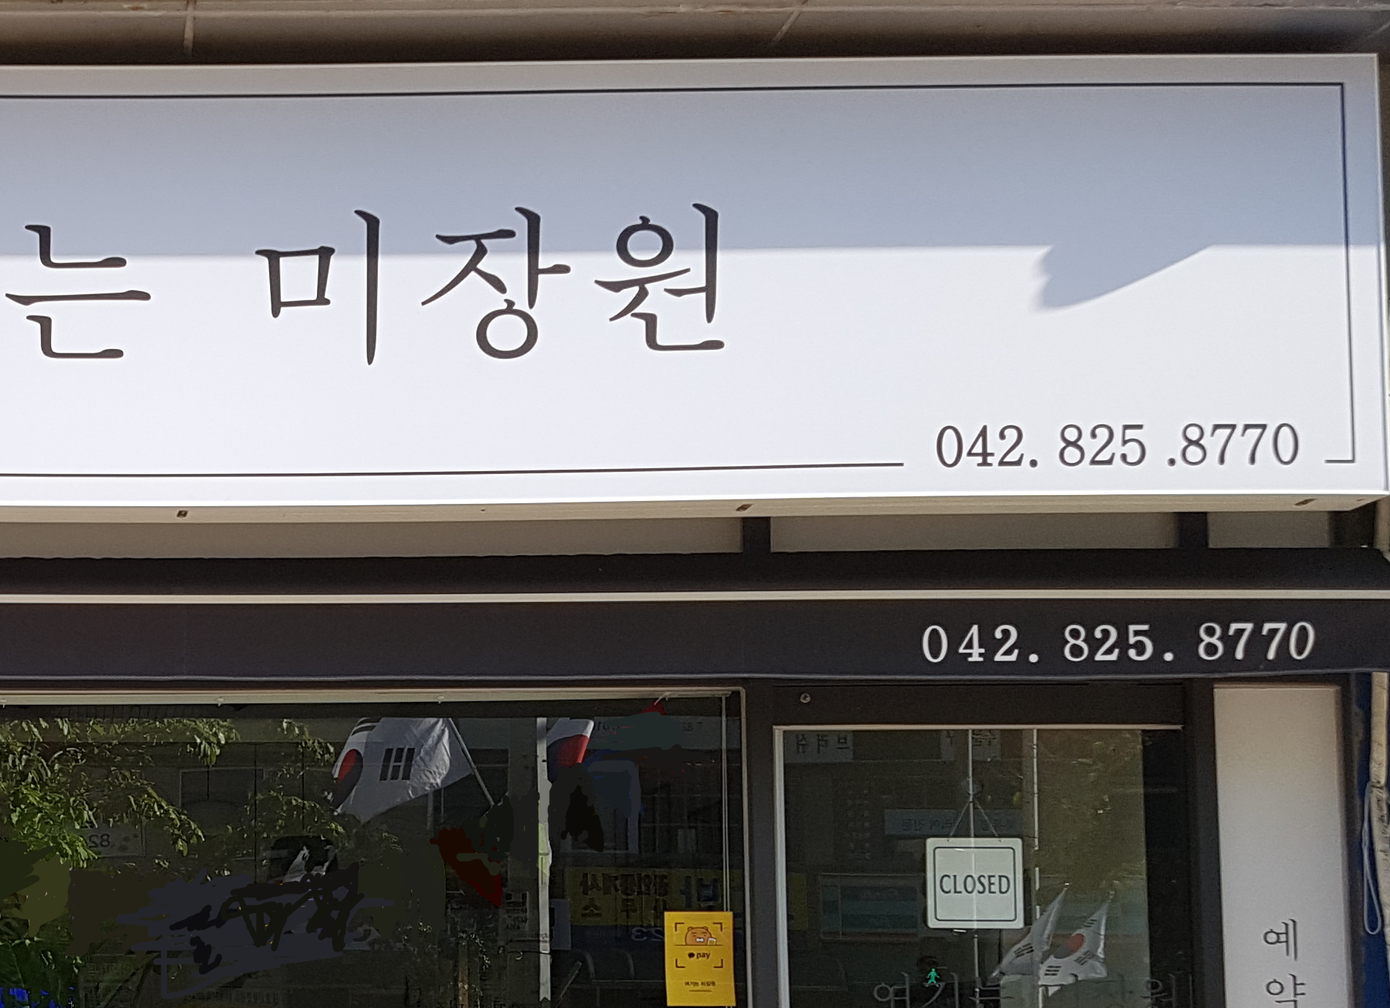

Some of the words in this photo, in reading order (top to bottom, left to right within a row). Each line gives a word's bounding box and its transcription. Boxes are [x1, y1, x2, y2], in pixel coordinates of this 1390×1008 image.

[255, 203, 724, 366] 미장원
[936, 424, 1038, 468] 042.
[922, 624, 1039, 663] 042.
[1063, 624, 1174, 662] 825.
[1198, 621, 1315, 661] 8770
[939, 874, 1011, 895] CLOSED
